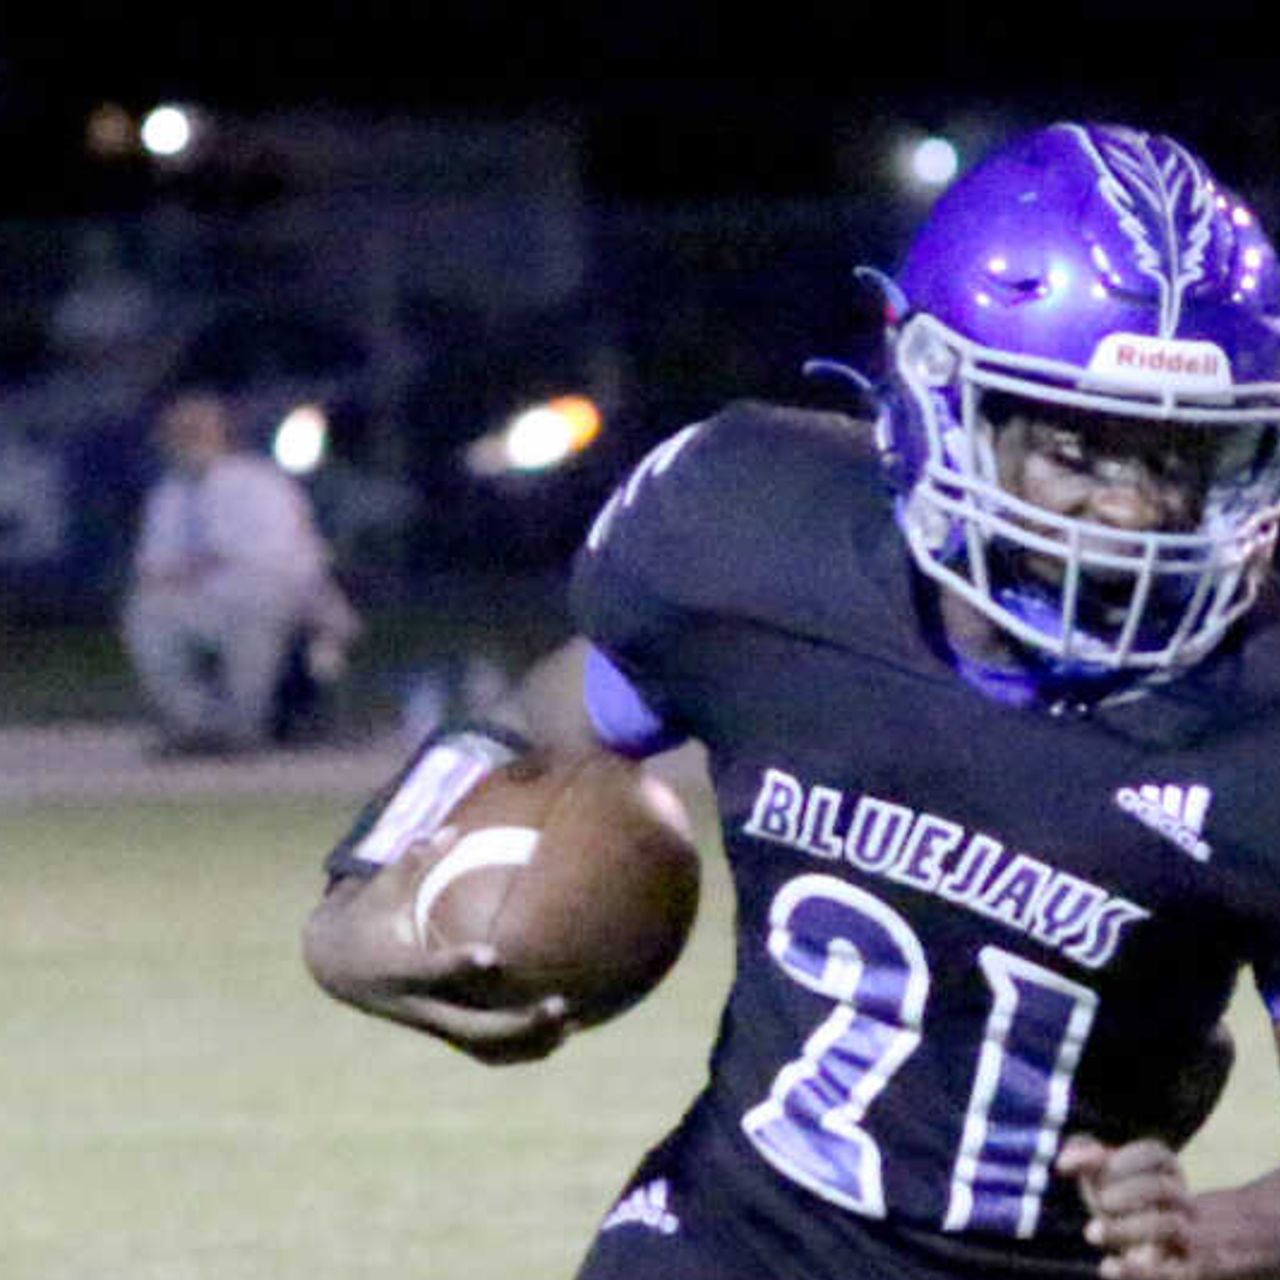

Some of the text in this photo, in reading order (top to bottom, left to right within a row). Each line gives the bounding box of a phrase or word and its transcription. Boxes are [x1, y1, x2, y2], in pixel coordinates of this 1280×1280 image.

[1116, 343, 1218, 377] Riddell
[744, 767, 1151, 969] BLUEJAYS
[740, 872, 1100, 1240] 21
